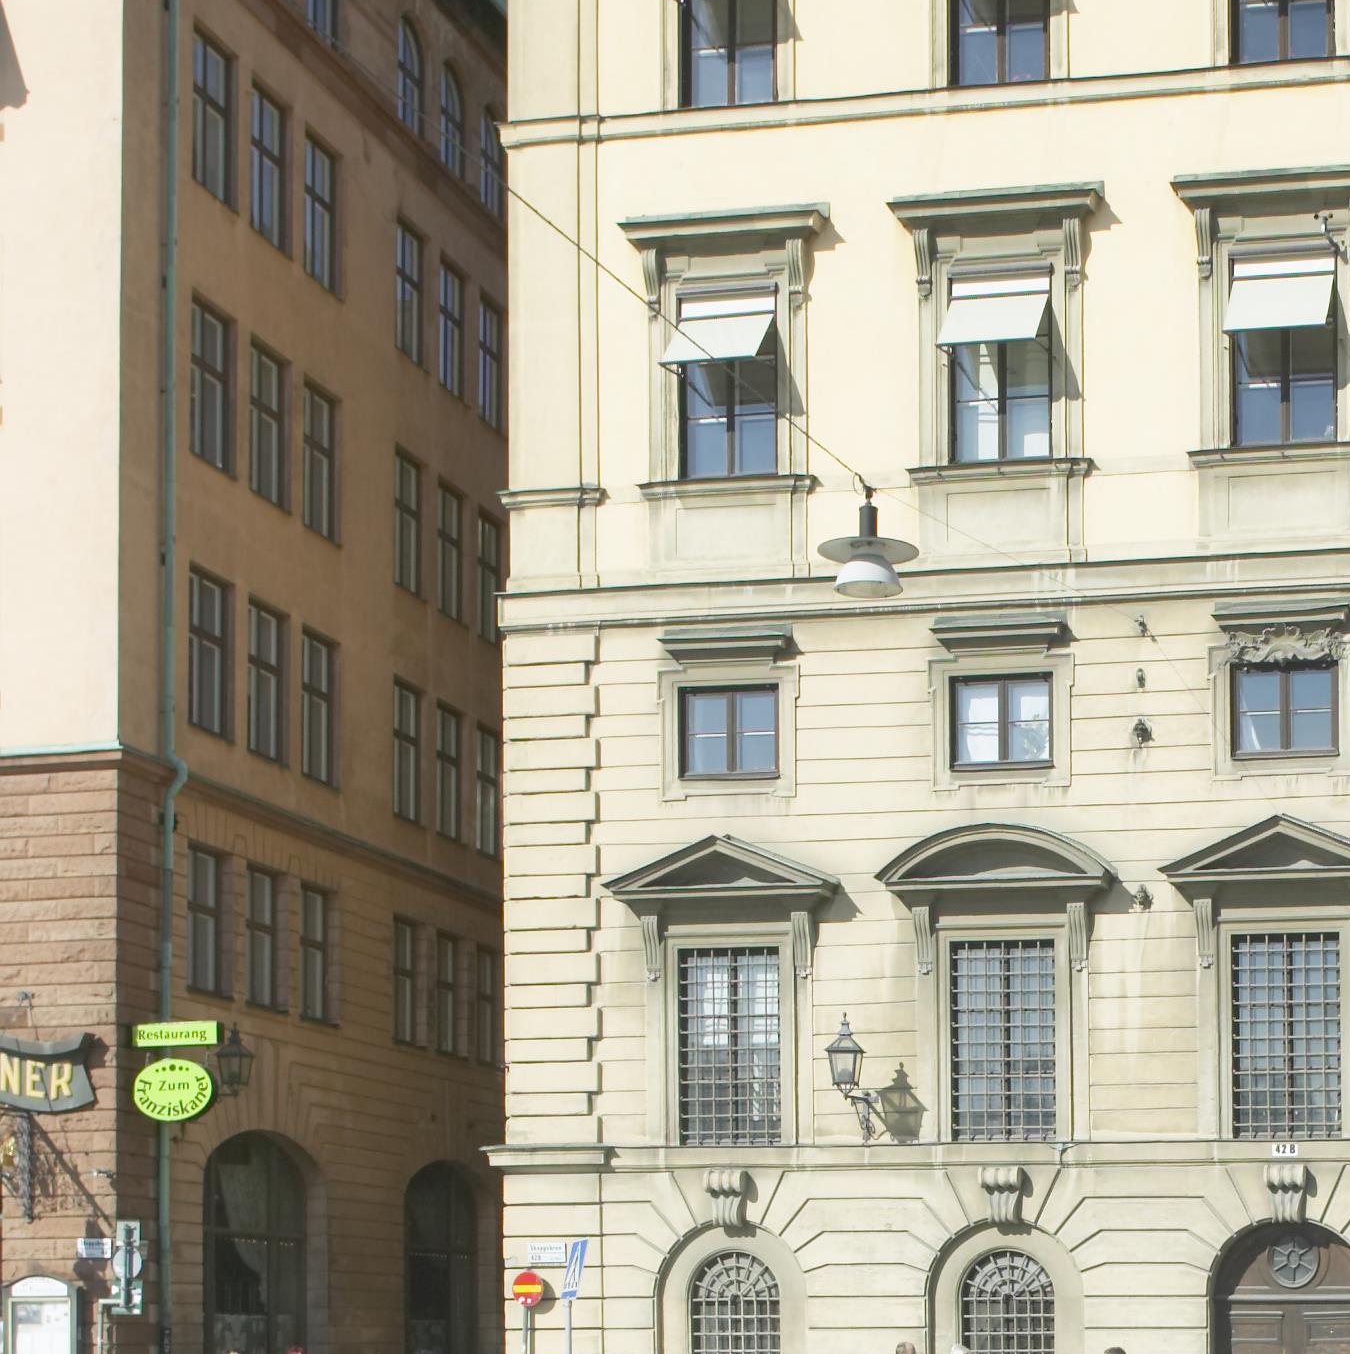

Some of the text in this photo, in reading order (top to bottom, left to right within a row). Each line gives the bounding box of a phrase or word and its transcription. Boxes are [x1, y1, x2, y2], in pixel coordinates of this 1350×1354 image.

[138, 1029, 207, 1042] Restaurang
[159, 1080, 189, 1091] Zum
[137, 1076, 208, 1117] Franziskaner
